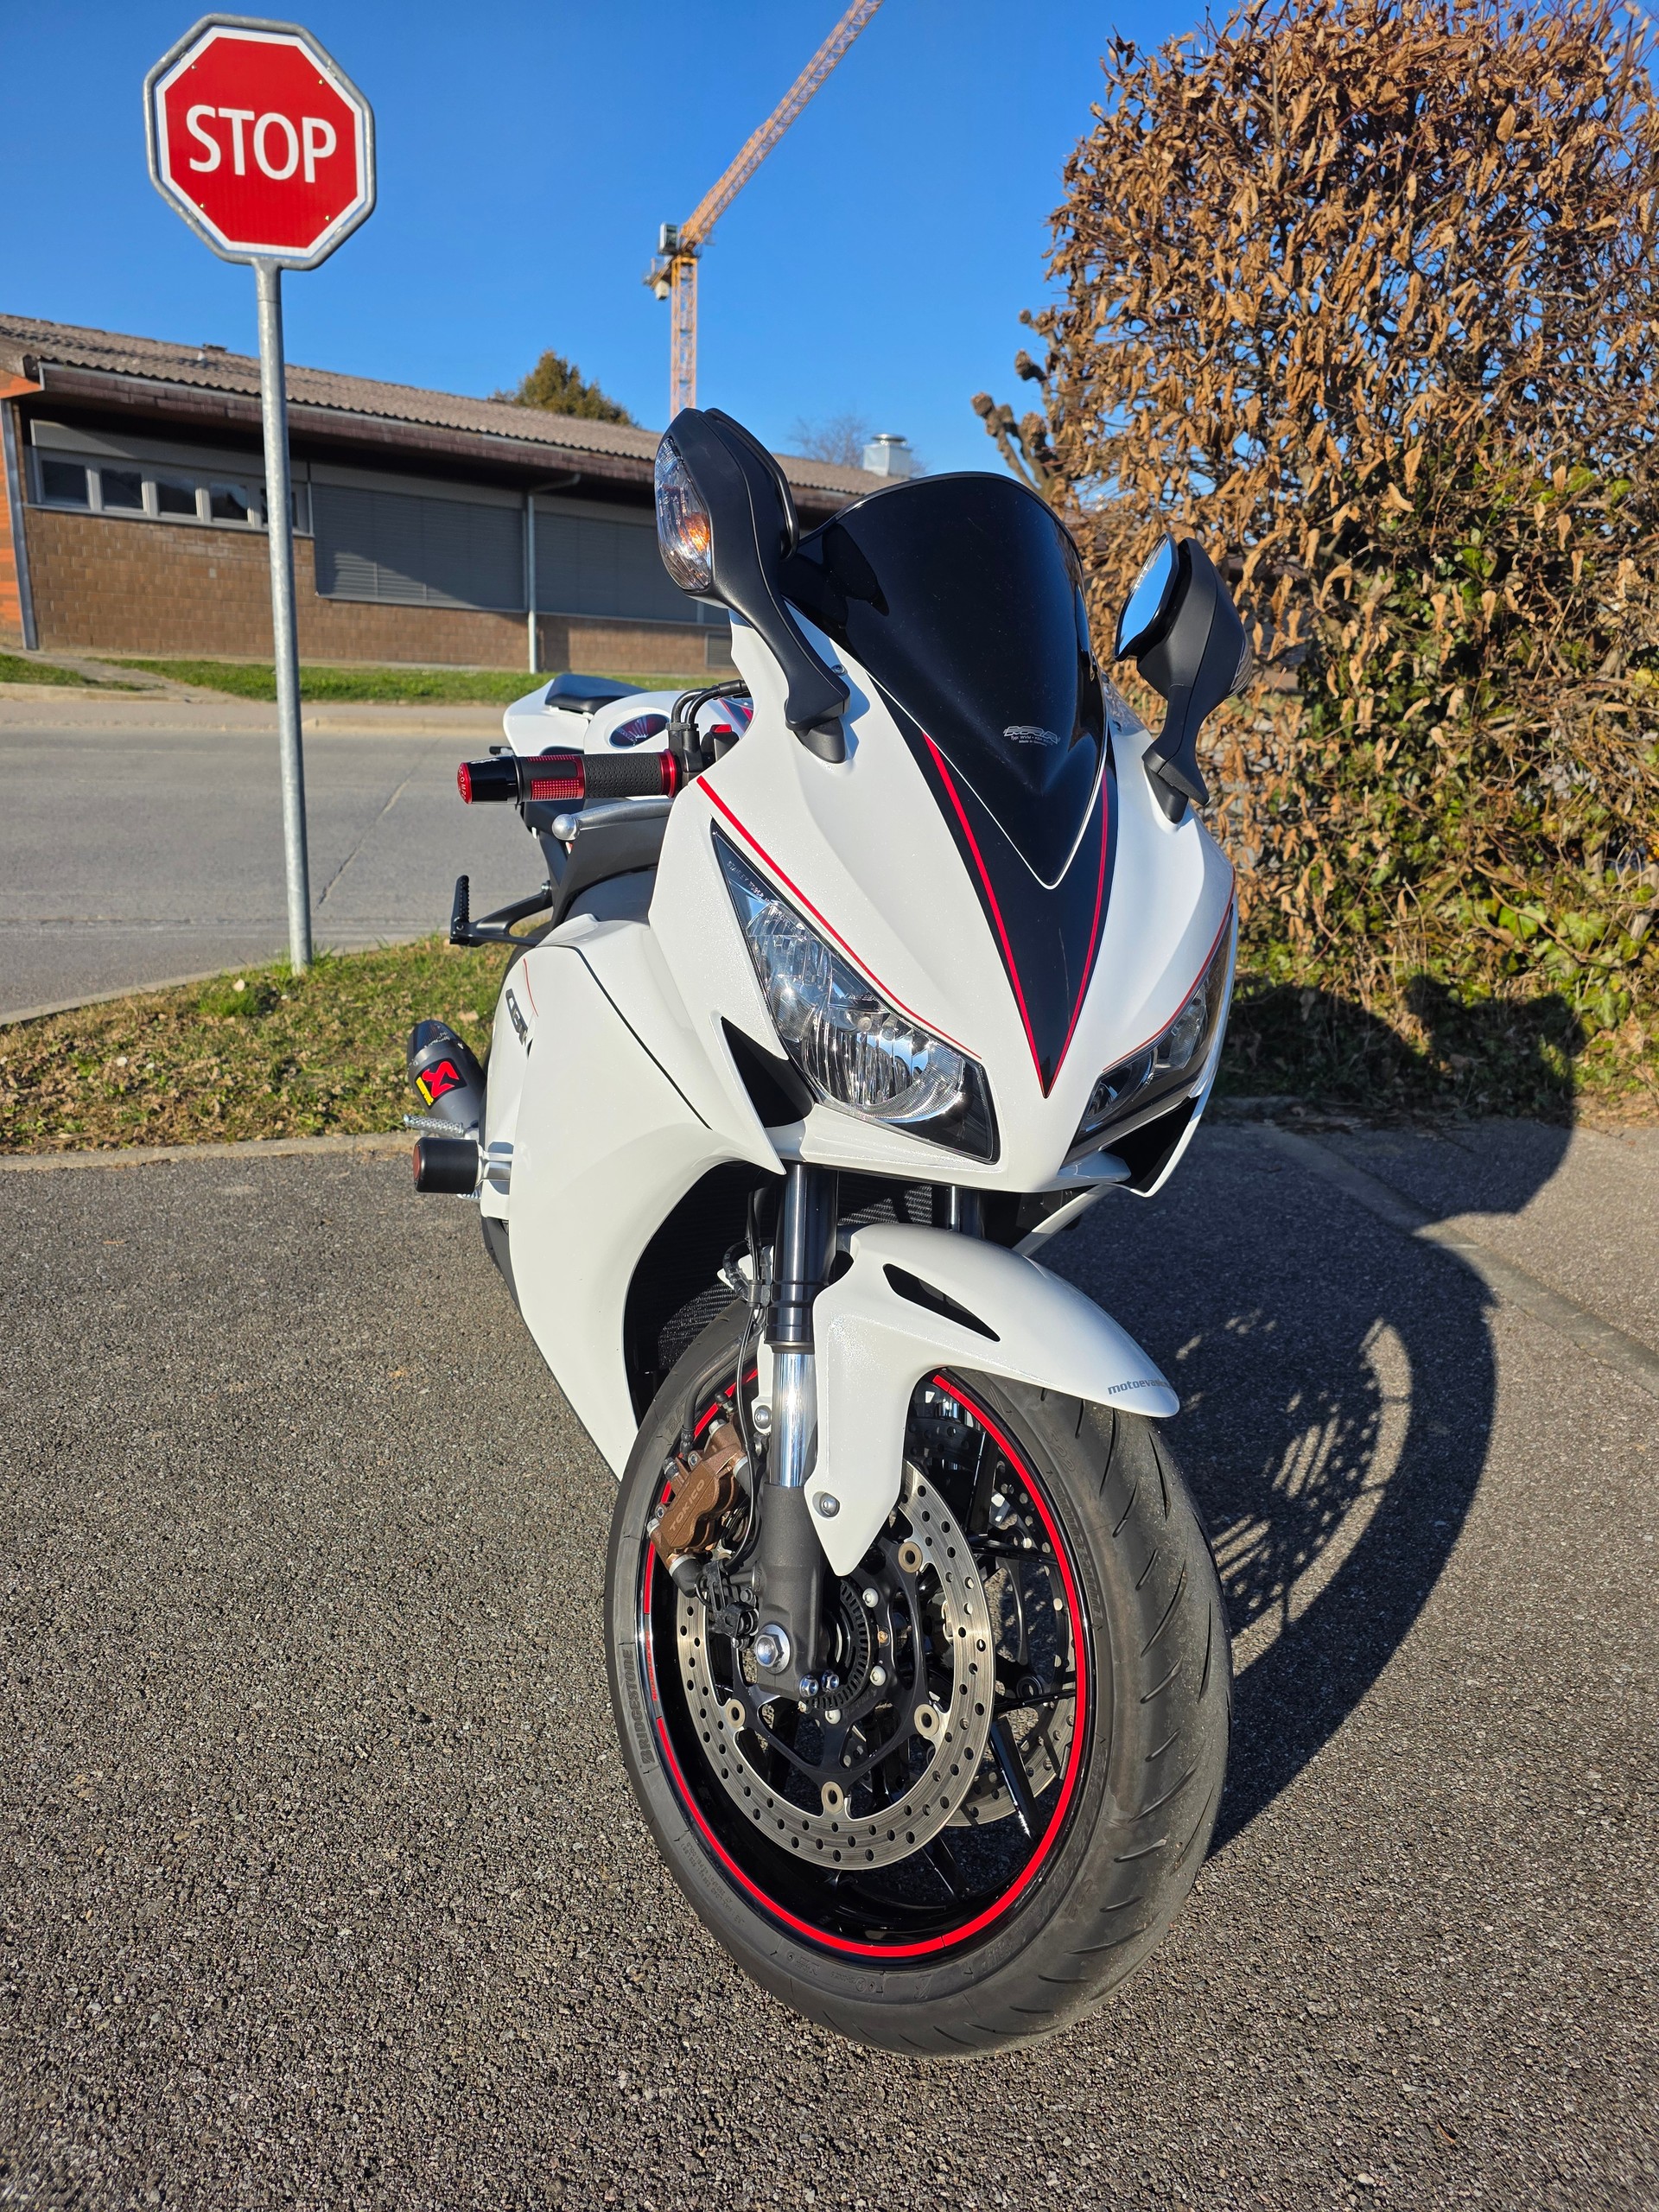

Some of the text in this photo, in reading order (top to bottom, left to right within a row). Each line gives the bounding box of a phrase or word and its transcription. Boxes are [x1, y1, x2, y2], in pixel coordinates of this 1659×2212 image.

[186, 104, 337, 183] STOP
[669, 1478, 706, 1532] TOKICO
[622, 1649, 656, 1764] BRIDGESTONE
